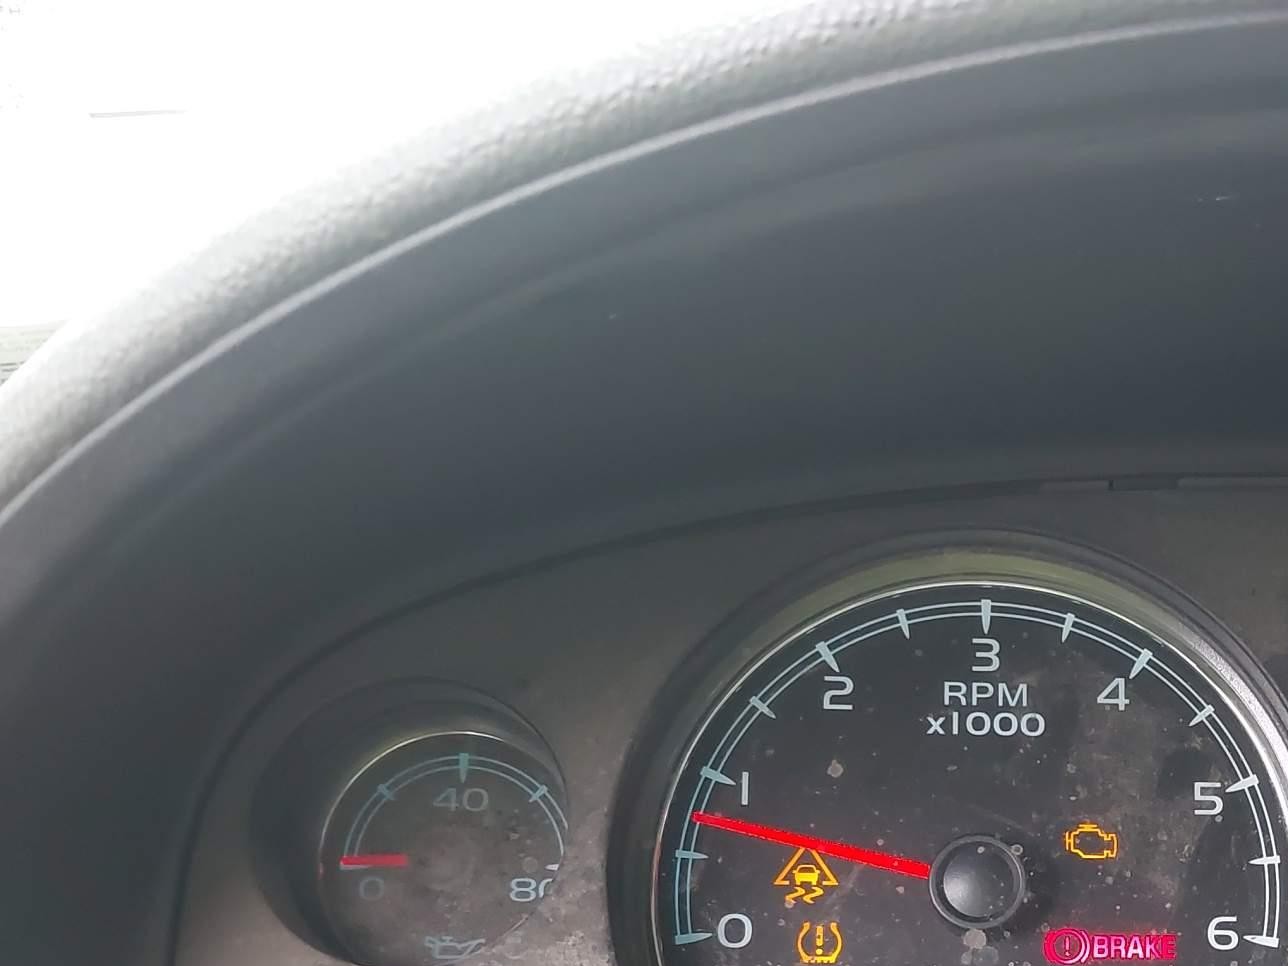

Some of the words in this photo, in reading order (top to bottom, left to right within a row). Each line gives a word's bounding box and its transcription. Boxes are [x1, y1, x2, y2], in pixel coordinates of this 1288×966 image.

[972, 639, 999, 671] 3
[823, 677, 853, 709] 2
[944, 684, 1028, 705] RPM
[1098, 679, 1129, 710] 4
[926, 713, 1045, 736] x1000
[432, 788, 489, 811] 40
[742, 772, 748, 804] 1
[1194, 782, 1222, 815] 5
[358, 877, 385, 900] 0
[718, 914, 752, 948] 0
[1207, 917, 1239, 950] 6
[1093, 935, 1176, 959] BRAKE
